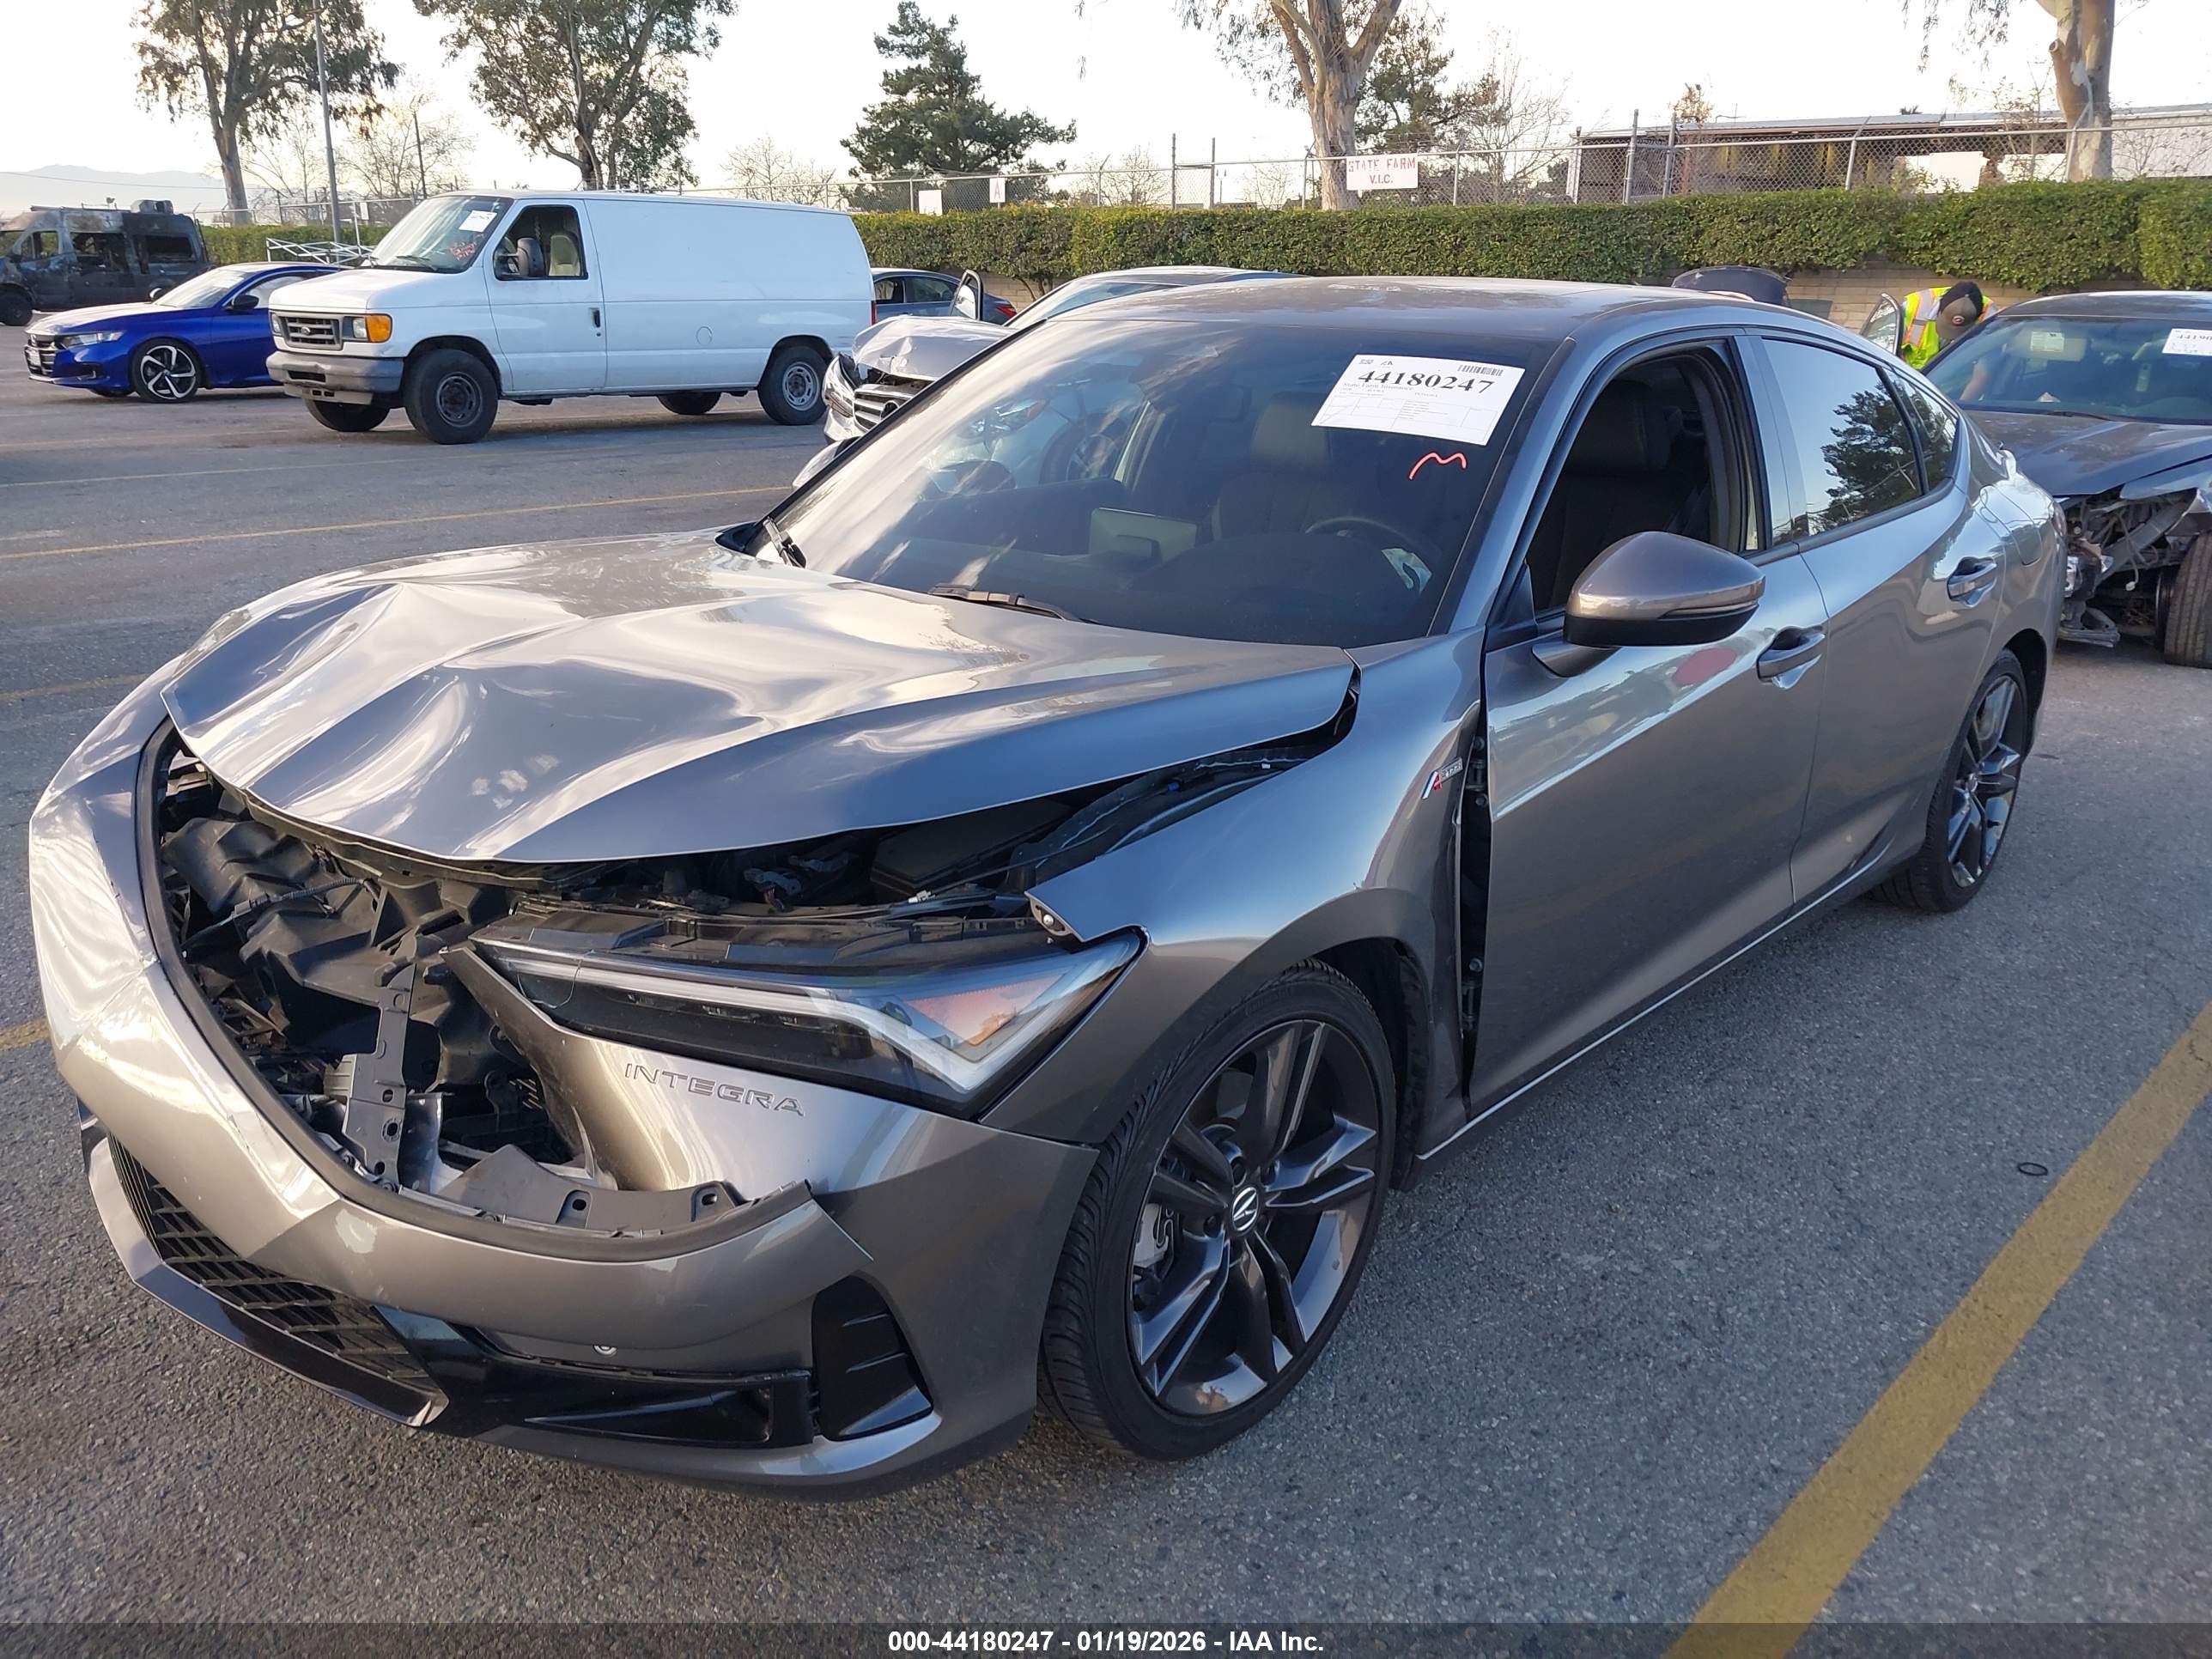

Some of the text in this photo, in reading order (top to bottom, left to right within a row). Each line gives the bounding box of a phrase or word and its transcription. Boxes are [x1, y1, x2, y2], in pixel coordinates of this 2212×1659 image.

[1348, 157, 1416, 172] STATE FARM
[1370, 174, 1393, 184] V.I.C.
[1358, 369, 1494, 394] 44180247
[624, 1063, 805, 1117] INTEGRA
